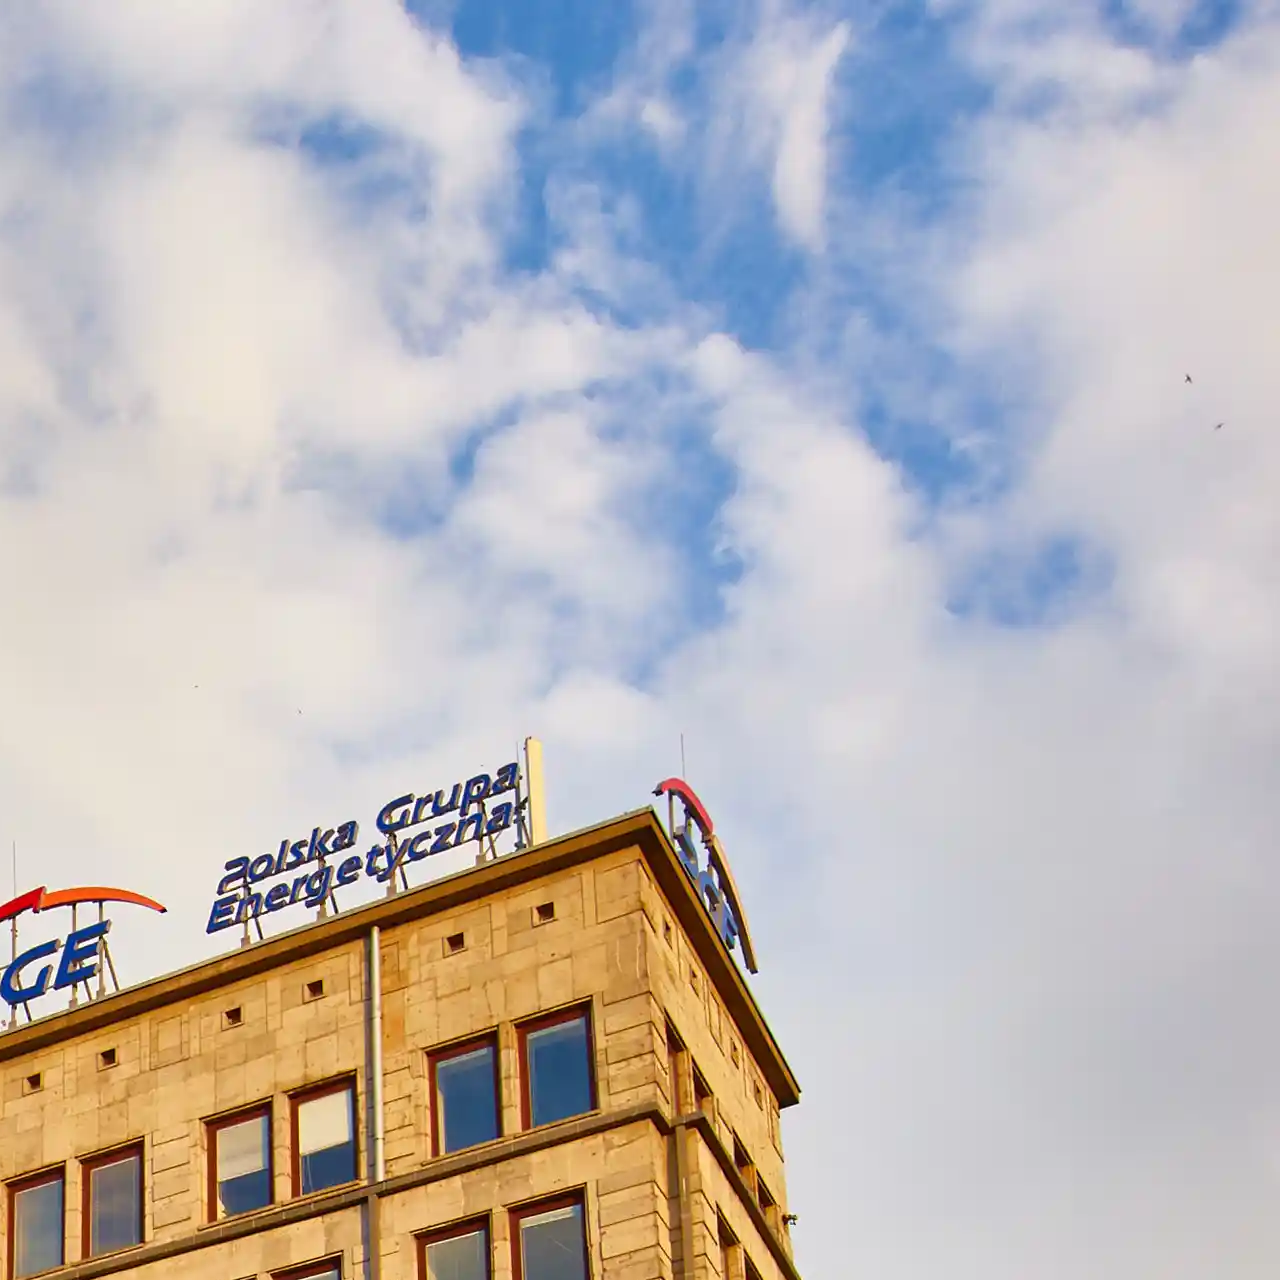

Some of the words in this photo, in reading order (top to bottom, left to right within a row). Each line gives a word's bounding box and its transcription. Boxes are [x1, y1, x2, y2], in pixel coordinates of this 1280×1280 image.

[206, 801, 515, 934] Energetyczna
[216, 820, 359, 896] Polska
[376, 762, 521, 834] Grupa
